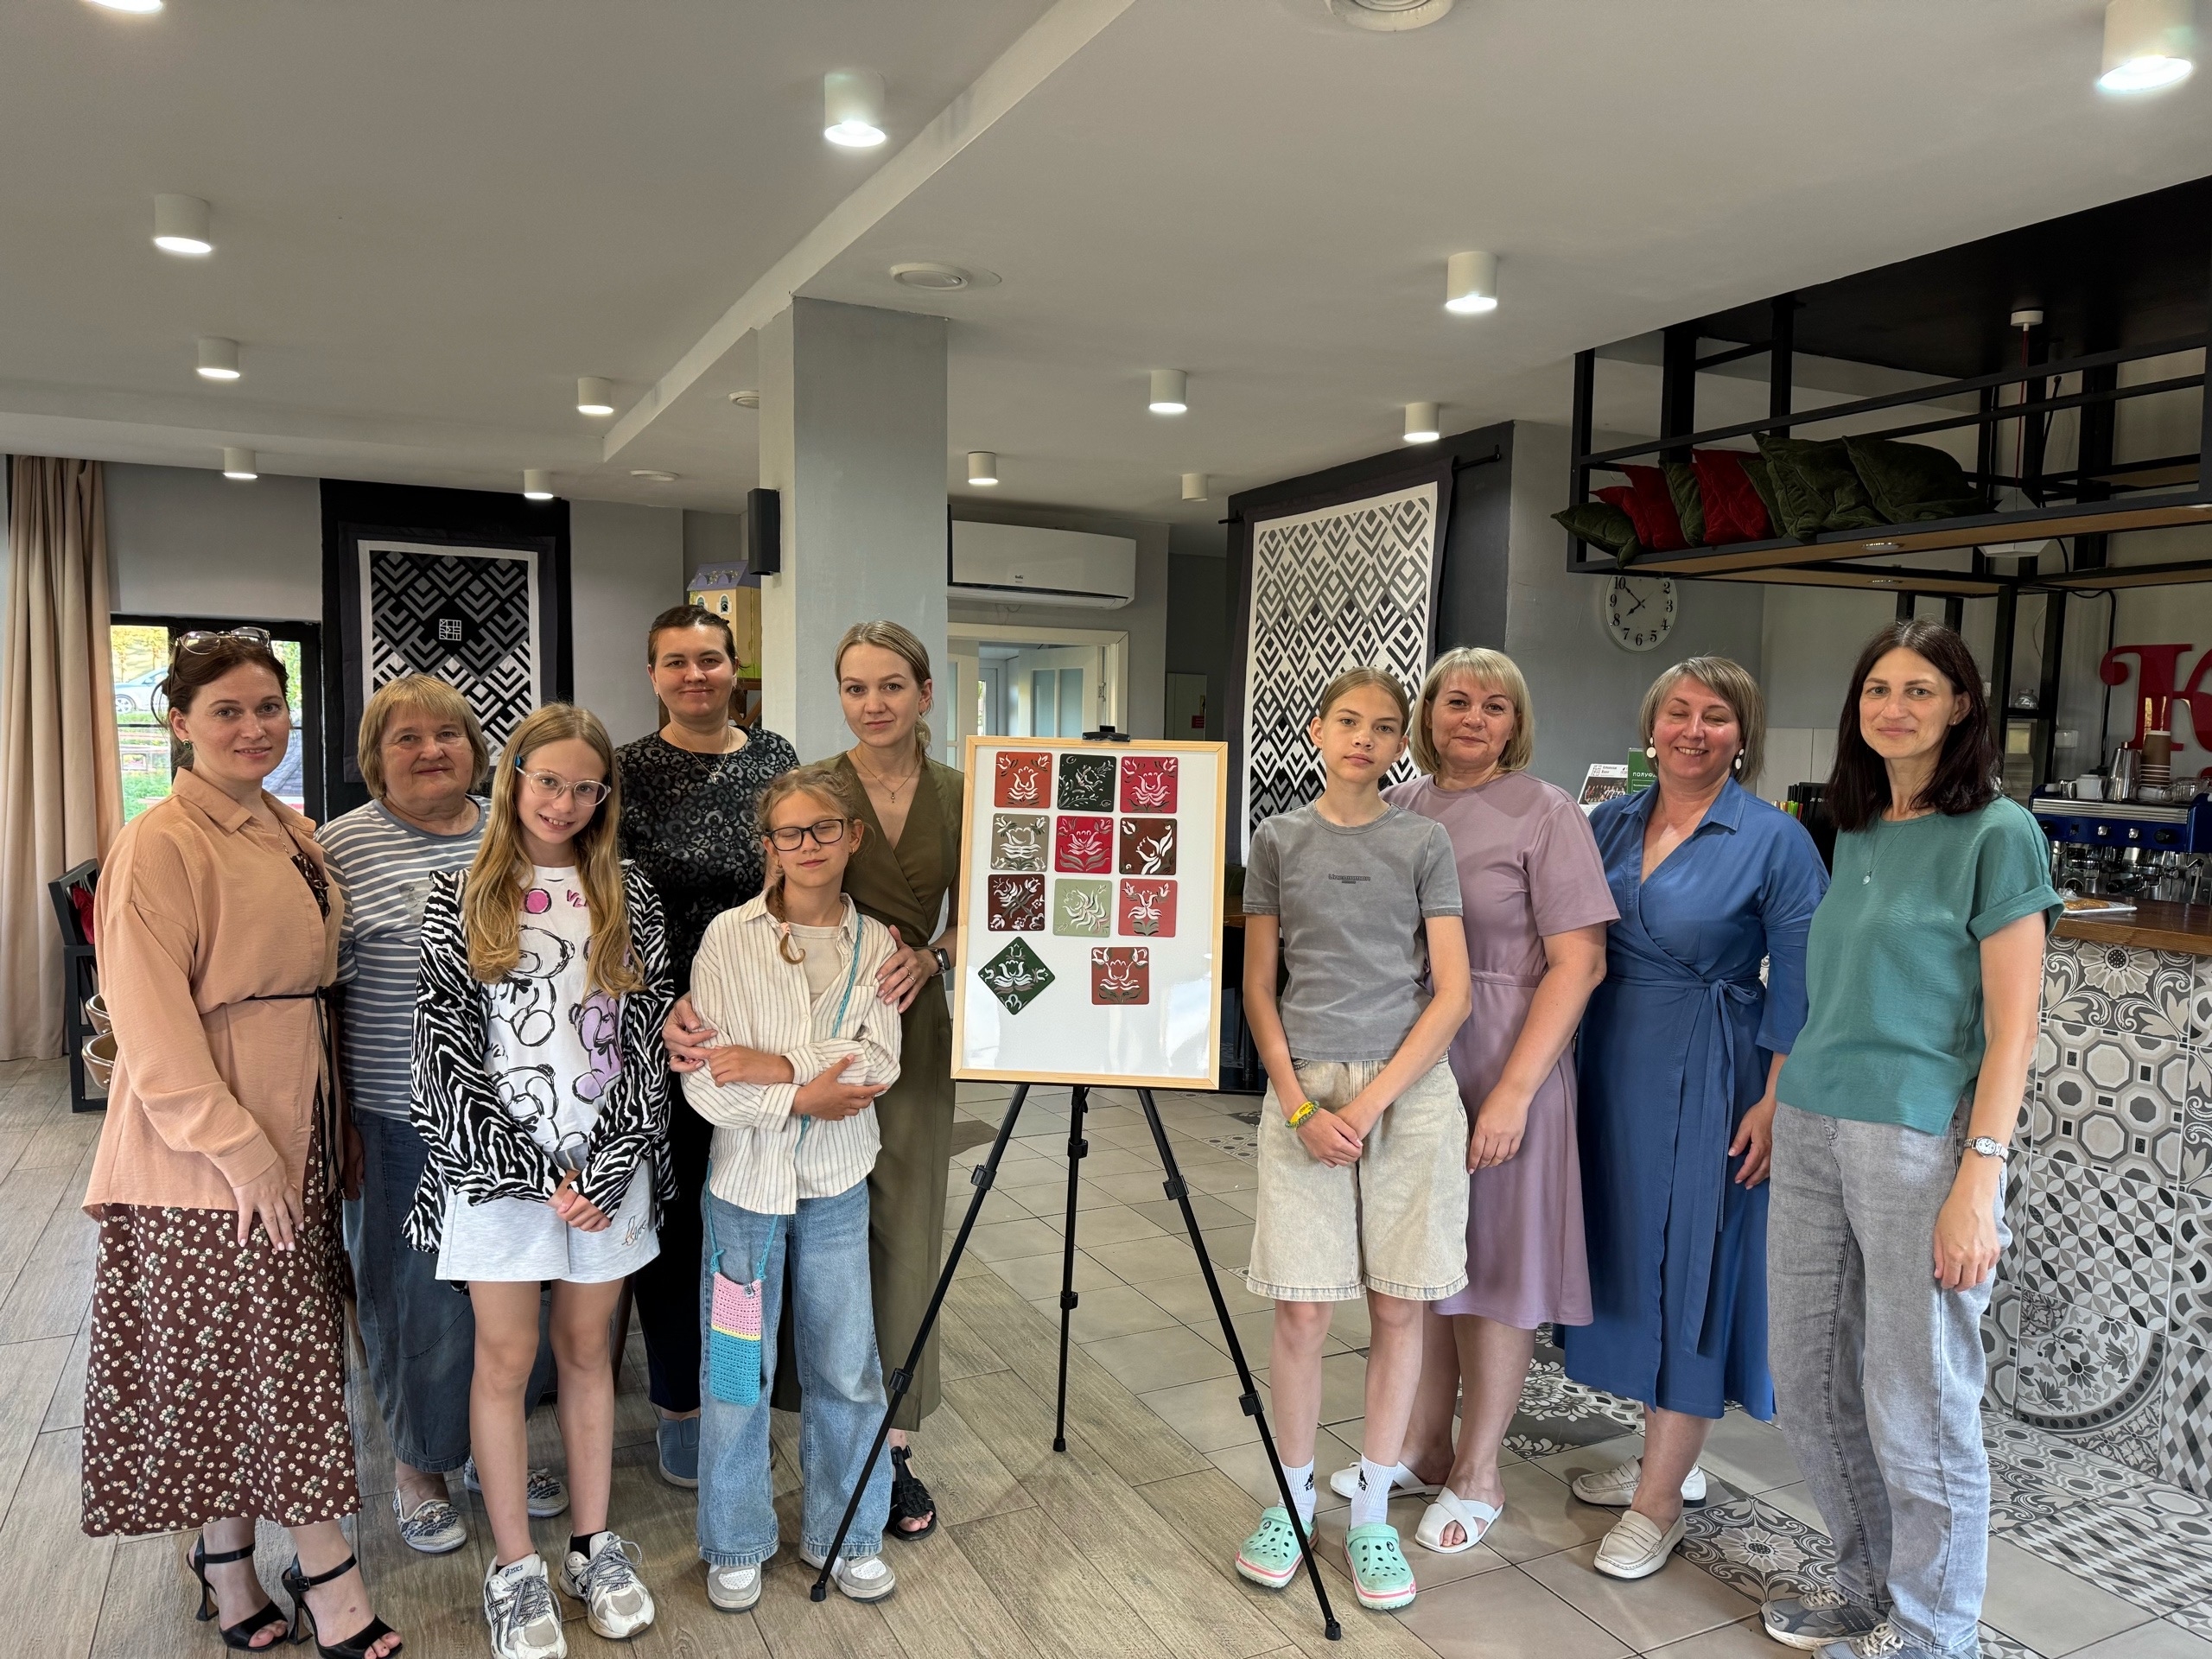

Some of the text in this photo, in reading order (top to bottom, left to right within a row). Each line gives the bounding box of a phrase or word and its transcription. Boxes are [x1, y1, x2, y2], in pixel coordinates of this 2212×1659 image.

[1614, 576, 1626, 590] 10
[1662, 581, 1671, 594] 2
[1610, 594, 1618, 607] 9
[1666, 599, 1673, 613] 3
[1612, 613, 1621, 626] 8
[1661, 617, 1669, 631] 4
[1623, 627, 1630, 640] 7
[1636, 632, 1643, 646] 6
[1649, 630, 1657, 642] 5
